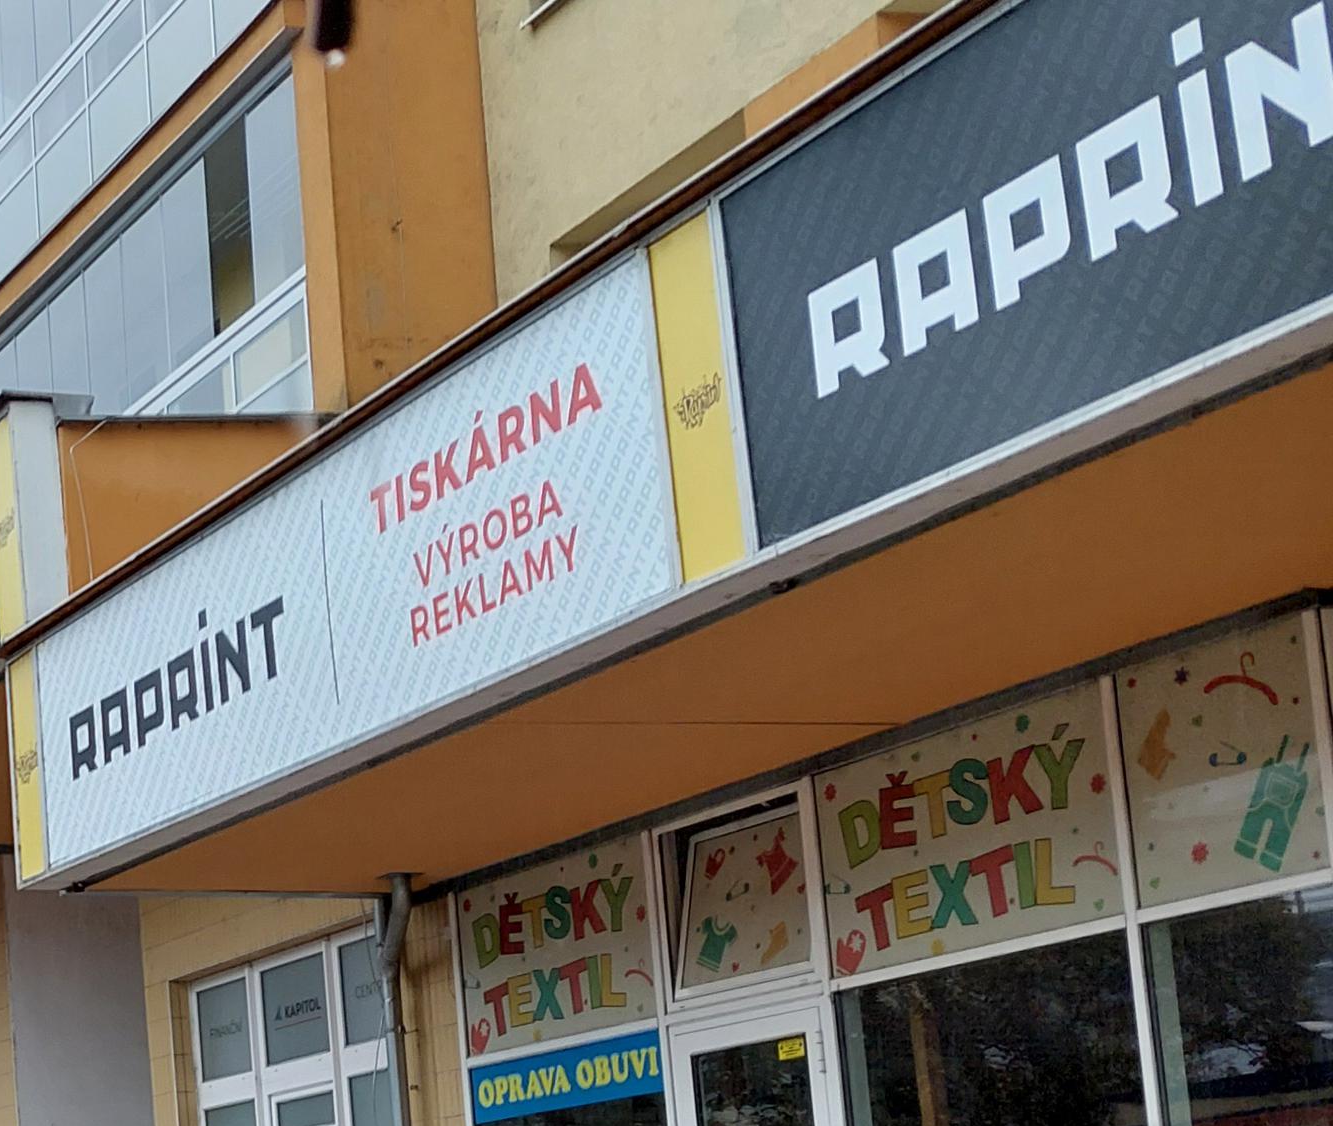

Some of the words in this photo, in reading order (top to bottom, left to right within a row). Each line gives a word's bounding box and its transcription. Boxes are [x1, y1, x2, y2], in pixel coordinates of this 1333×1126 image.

[807, 1, 1333, 398] RAPRIN
[370, 362, 603, 534] TISKÁRNA
[410, 524, 580, 648] REKLAMY
[413, 481, 564, 587] VÝROBA
[69, 596, 284, 781] RAPRINT
[838, 723, 1085, 869] DĚTSKÝ
[472, 863, 633, 969] DĚTSKÝ
[855, 838, 1075, 951] TEXTIL
[285, 997, 321, 1018] KAPITOL
[484, 953, 627, 1037] TEXTIL
[478, 1065, 571, 1108] OPRAVA
[576, 1045, 660, 1089] OBUVI
